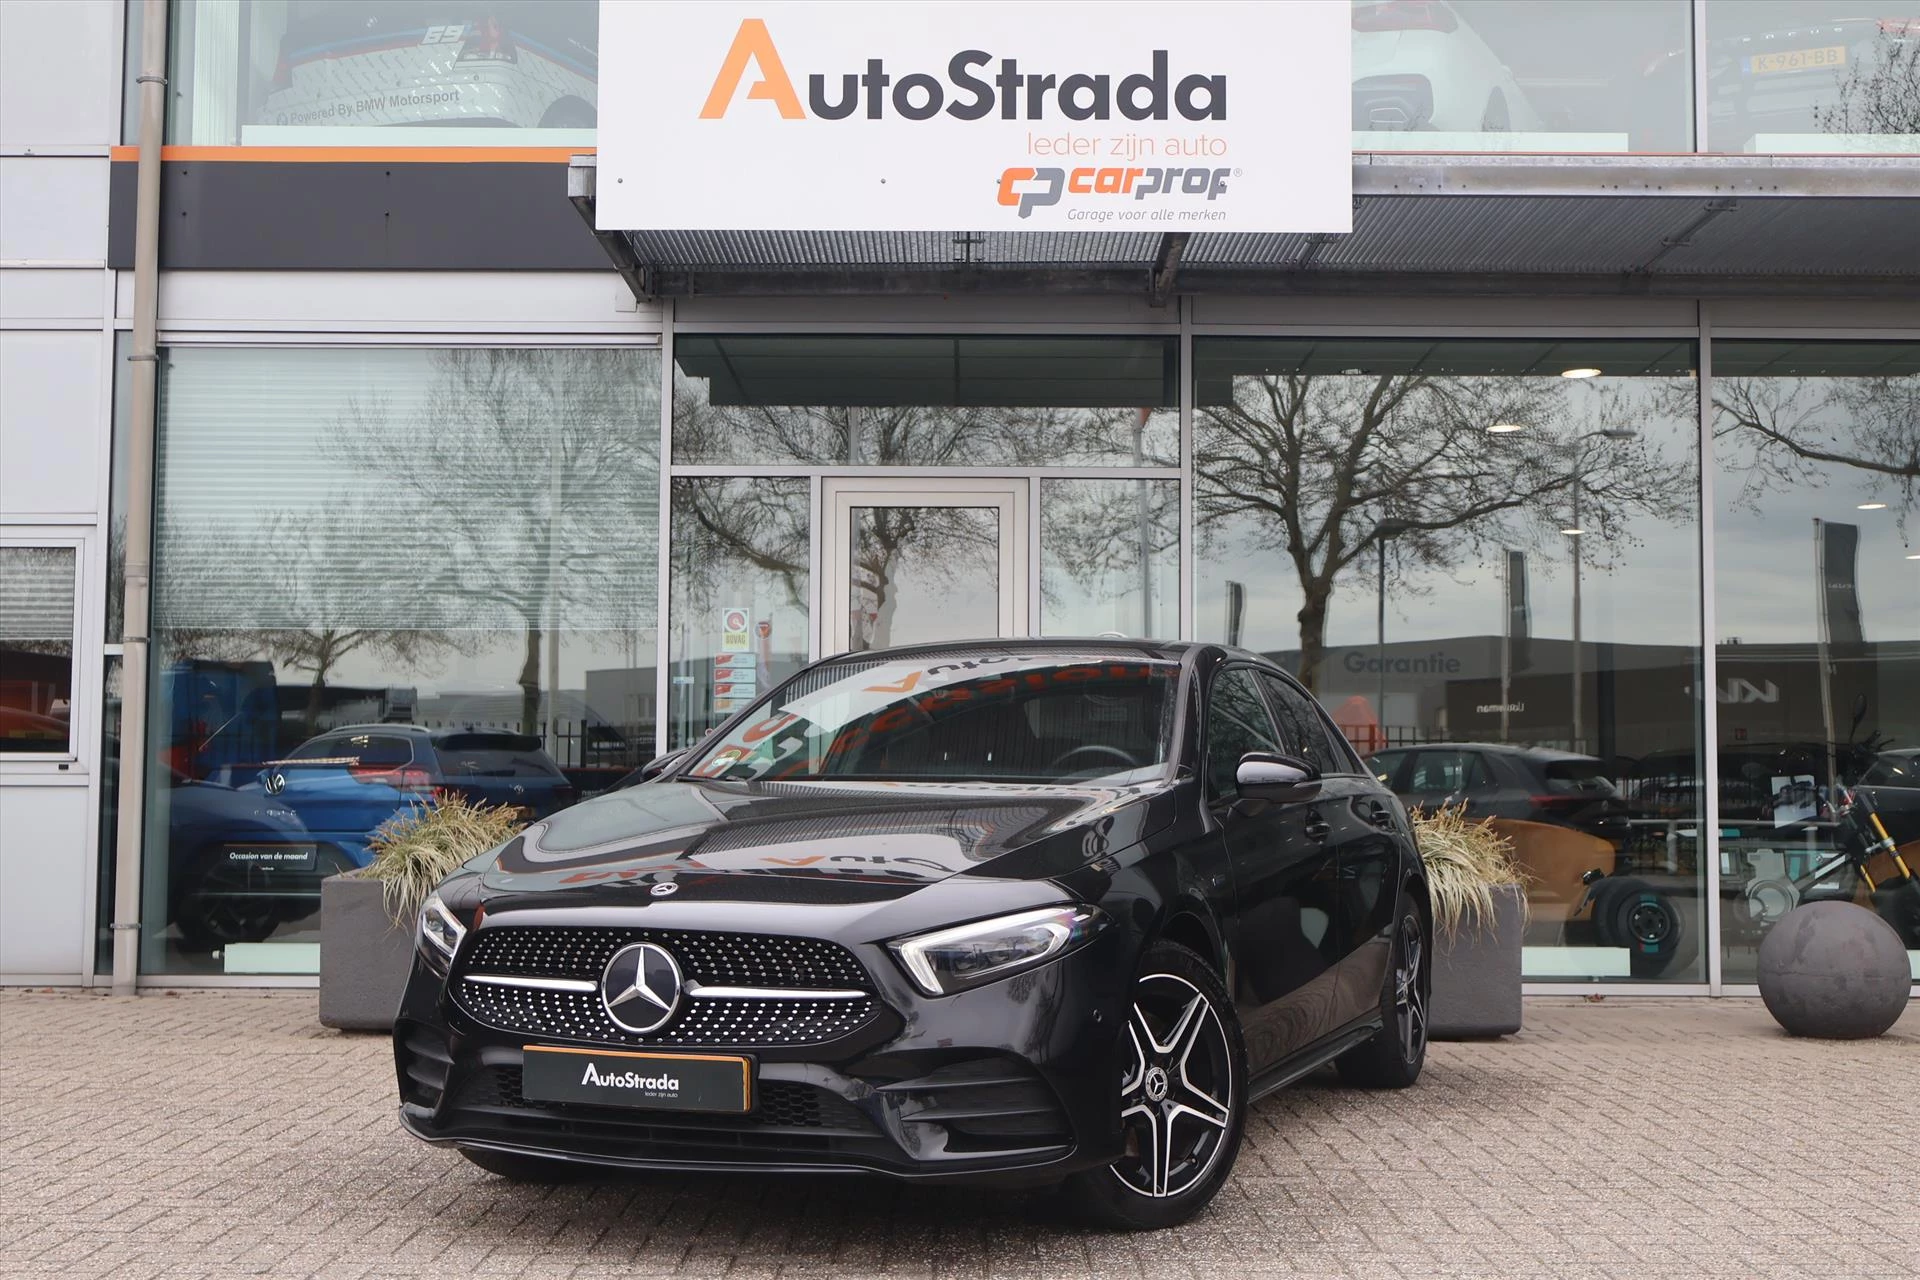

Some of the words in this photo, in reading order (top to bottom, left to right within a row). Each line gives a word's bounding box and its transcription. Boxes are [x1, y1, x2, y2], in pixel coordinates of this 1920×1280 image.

[421, 25, 465, 45] 69
[698, 18, 1227, 121] AutoStrada
[1757, 49, 1839, 70] K-961-BB
[290, 103, 335, 124] Powered
[338, 103, 353, 118] By
[356, 97, 386, 112] BMW
[389, 89, 460, 108] Motorsport
[1027, 132, 1101, 156] Ieder
[1110, 133, 1155, 162] zijn
[1165, 134, 1228, 156] auto
[1067, 208, 1114, 223] Garage
[1118, 211, 1148, 221] voor
[1150, 208, 1174, 221] alle
[1178, 208, 1227, 221] merken
[1343, 651, 1462, 674] Garantie
[229, 852, 259, 860] Occasion
[273, 851, 283, 860] de
[283, 852, 309, 860] maand
[581, 1062, 679, 1091] AutoStrada
